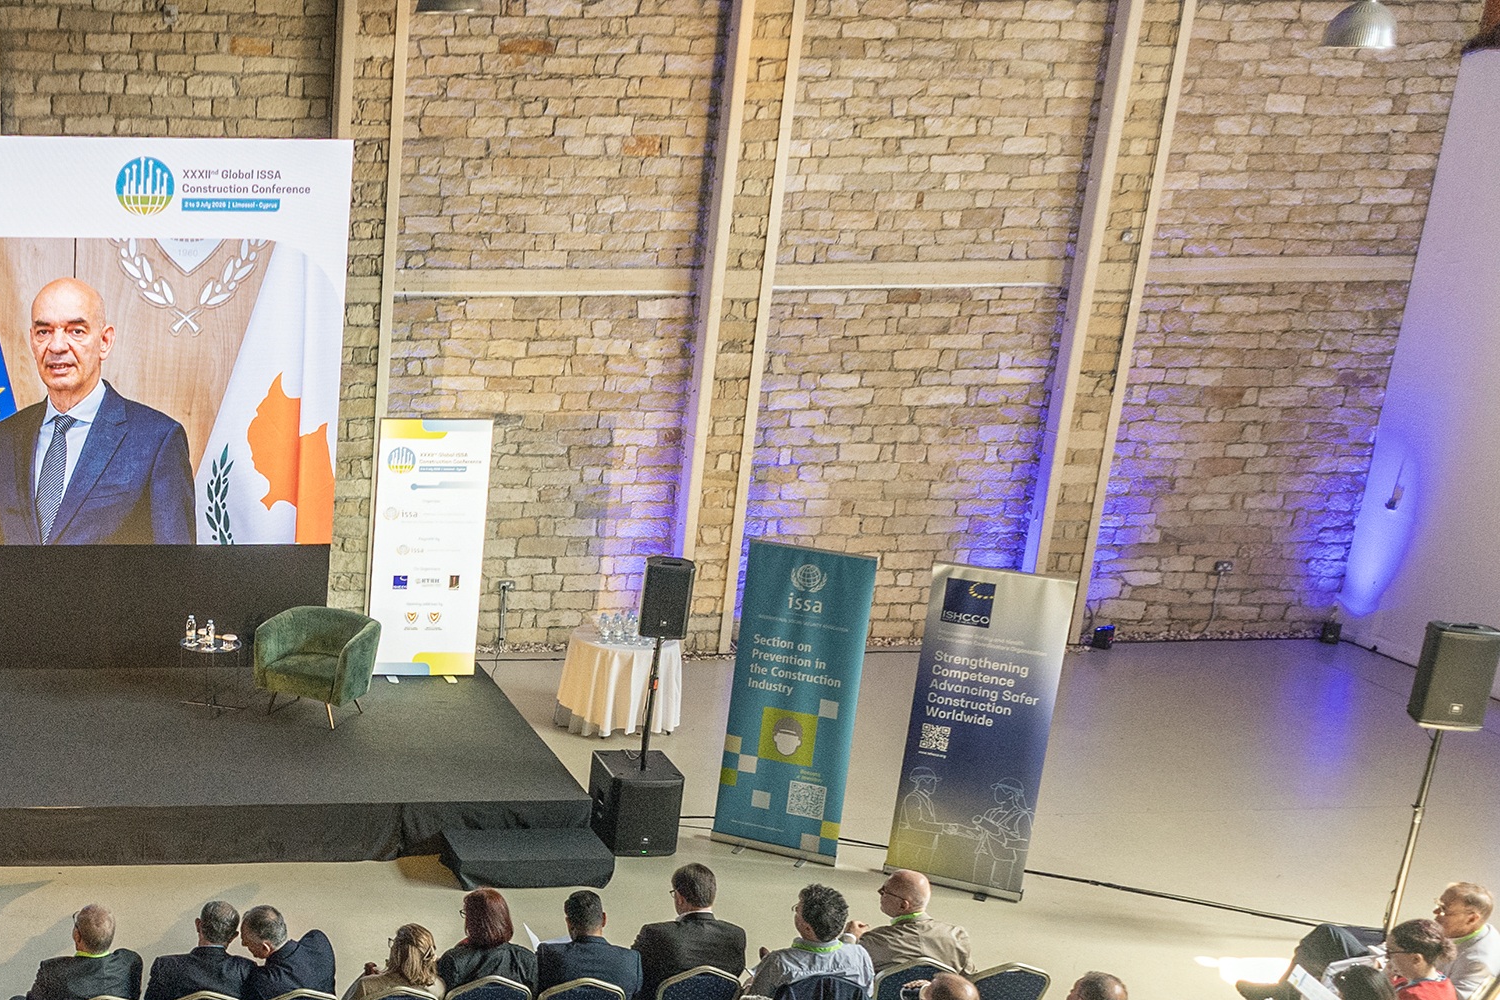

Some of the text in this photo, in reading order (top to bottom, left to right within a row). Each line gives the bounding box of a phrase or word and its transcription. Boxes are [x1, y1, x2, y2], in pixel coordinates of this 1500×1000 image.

[222, 170, 254, 179] Global
[256, 170, 281, 180] ISSA
[182, 184, 310, 194] Construction Conference
[200, 201, 211, 209] July
[259, 202, 277, 210] Cyprus
[402, 510, 418, 518] issa
[788, 592, 823, 614] issa
[943, 610, 989, 624] ISHCCO
[753, 633, 811, 652] Section on
[752, 648, 826, 669] Prevention in
[934, 650, 1029, 678] Strengthening
[749, 663, 841, 688] the Construction
[932, 664, 1015, 687] Competence
[748, 677, 793, 696] Industry
[929, 678, 1039, 705] Advancing Safer
[928, 692, 1012, 715] Construction
[926, 705, 993, 726] Worldwide
